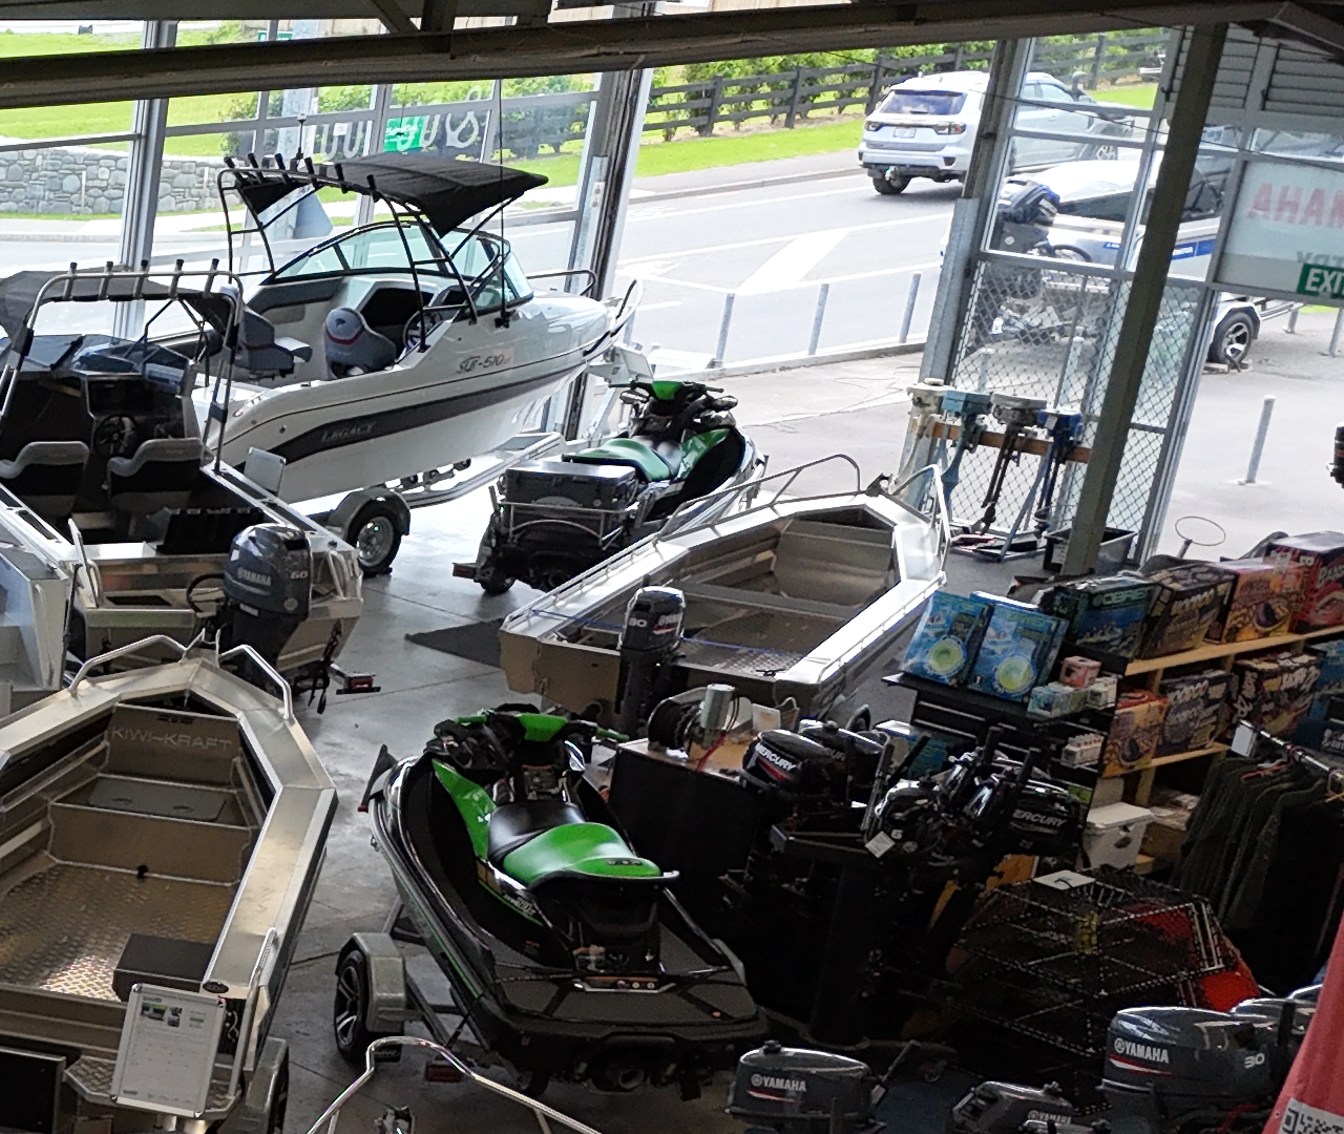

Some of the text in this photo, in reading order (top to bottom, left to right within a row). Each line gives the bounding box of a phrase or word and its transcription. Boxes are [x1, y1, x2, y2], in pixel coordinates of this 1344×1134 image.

[321, 421, 376, 443] LEGACY
[243, 569, 272, 587] YAMAHA
[754, 741, 798, 772] MERCURY
[1012, 809, 1068, 828] ERCURY
[1123, 1041, 1170, 1065] YAMAHA
[1244, 1052, 1266, 1069] 30
[763, 1075, 807, 1092] YAMAHA
